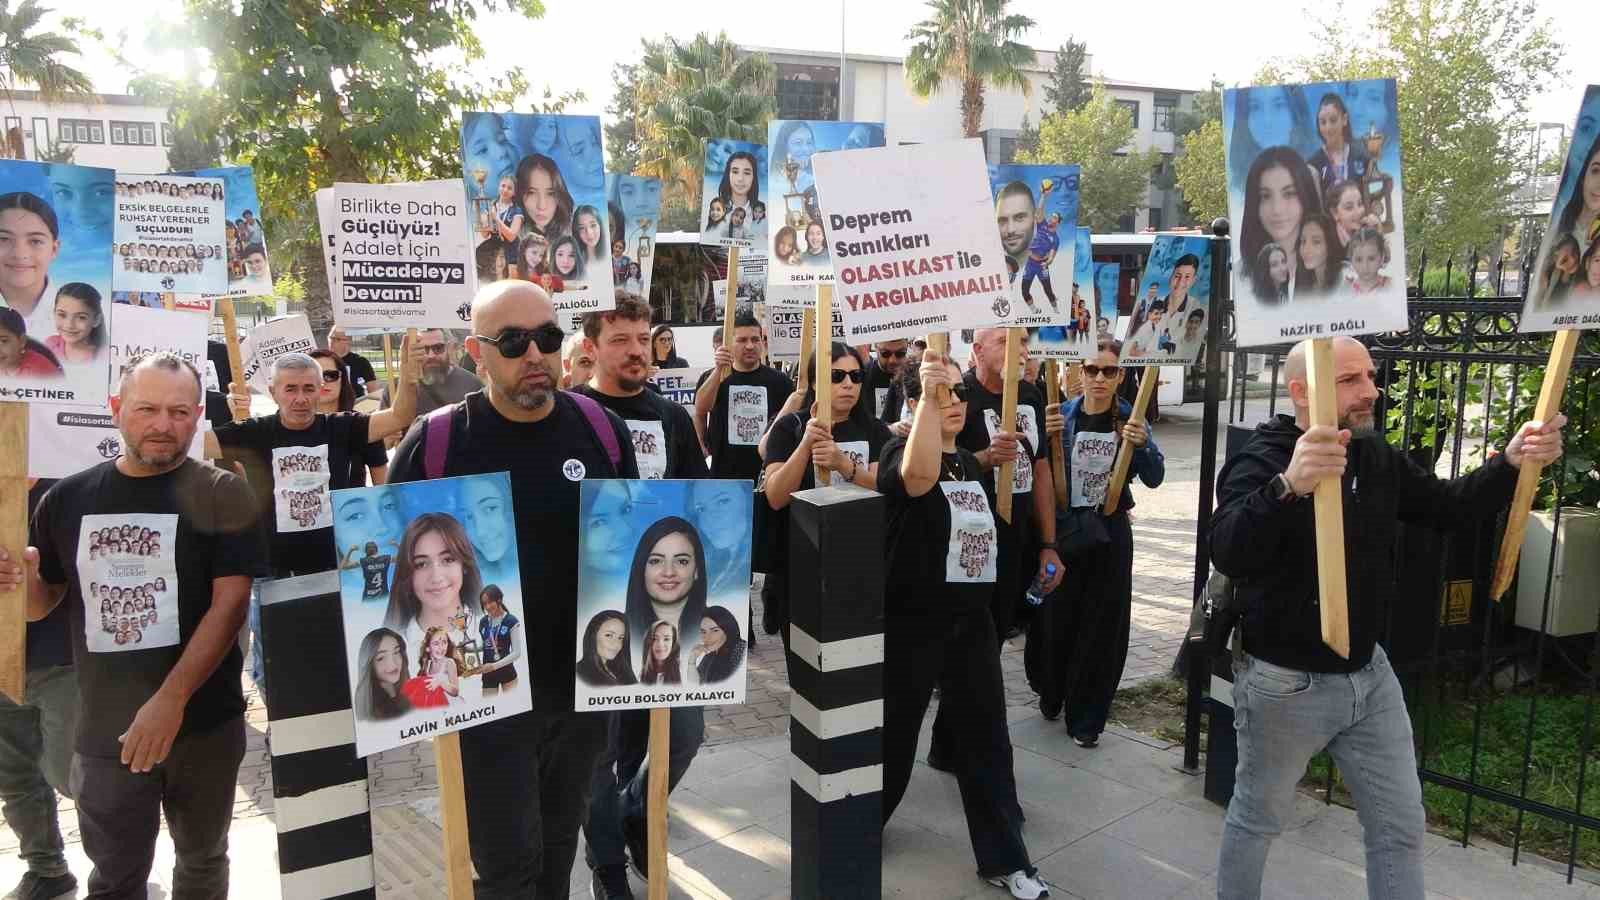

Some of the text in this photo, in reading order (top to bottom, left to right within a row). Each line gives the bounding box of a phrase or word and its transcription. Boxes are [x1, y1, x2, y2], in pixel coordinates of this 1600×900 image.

[119, 202, 209, 214] EKSİK BELGELERLE
[341, 199, 456, 216] Birlikte Daha
[119, 214, 210, 225] RUHSAT VERENLER
[341, 218, 440, 239] Güçlüyüz!
[830, 208, 912, 233] Deprem
[135, 225, 193, 235] SUÇLUDUR!
[342, 240, 402, 256] Adalet
[409, 239, 440, 261] İçin
[835, 233, 930, 258] Sanıkları
[343, 262, 464, 284] Mücadeleye
[841, 251, 982, 285] OLASI KAST ile
[343, 285, 422, 301] Devam!
[845, 273, 1002, 312] YARGILANMALI!
[1280, 318, 1365, 337] NAZİFE DAĞLI
[16, 387, 75, 400] ÇETİNER
[588, 690, 735, 706] DUYGU BOLSOY KALAYCI
[400, 705, 495, 739] LAVİN KALAYCI
